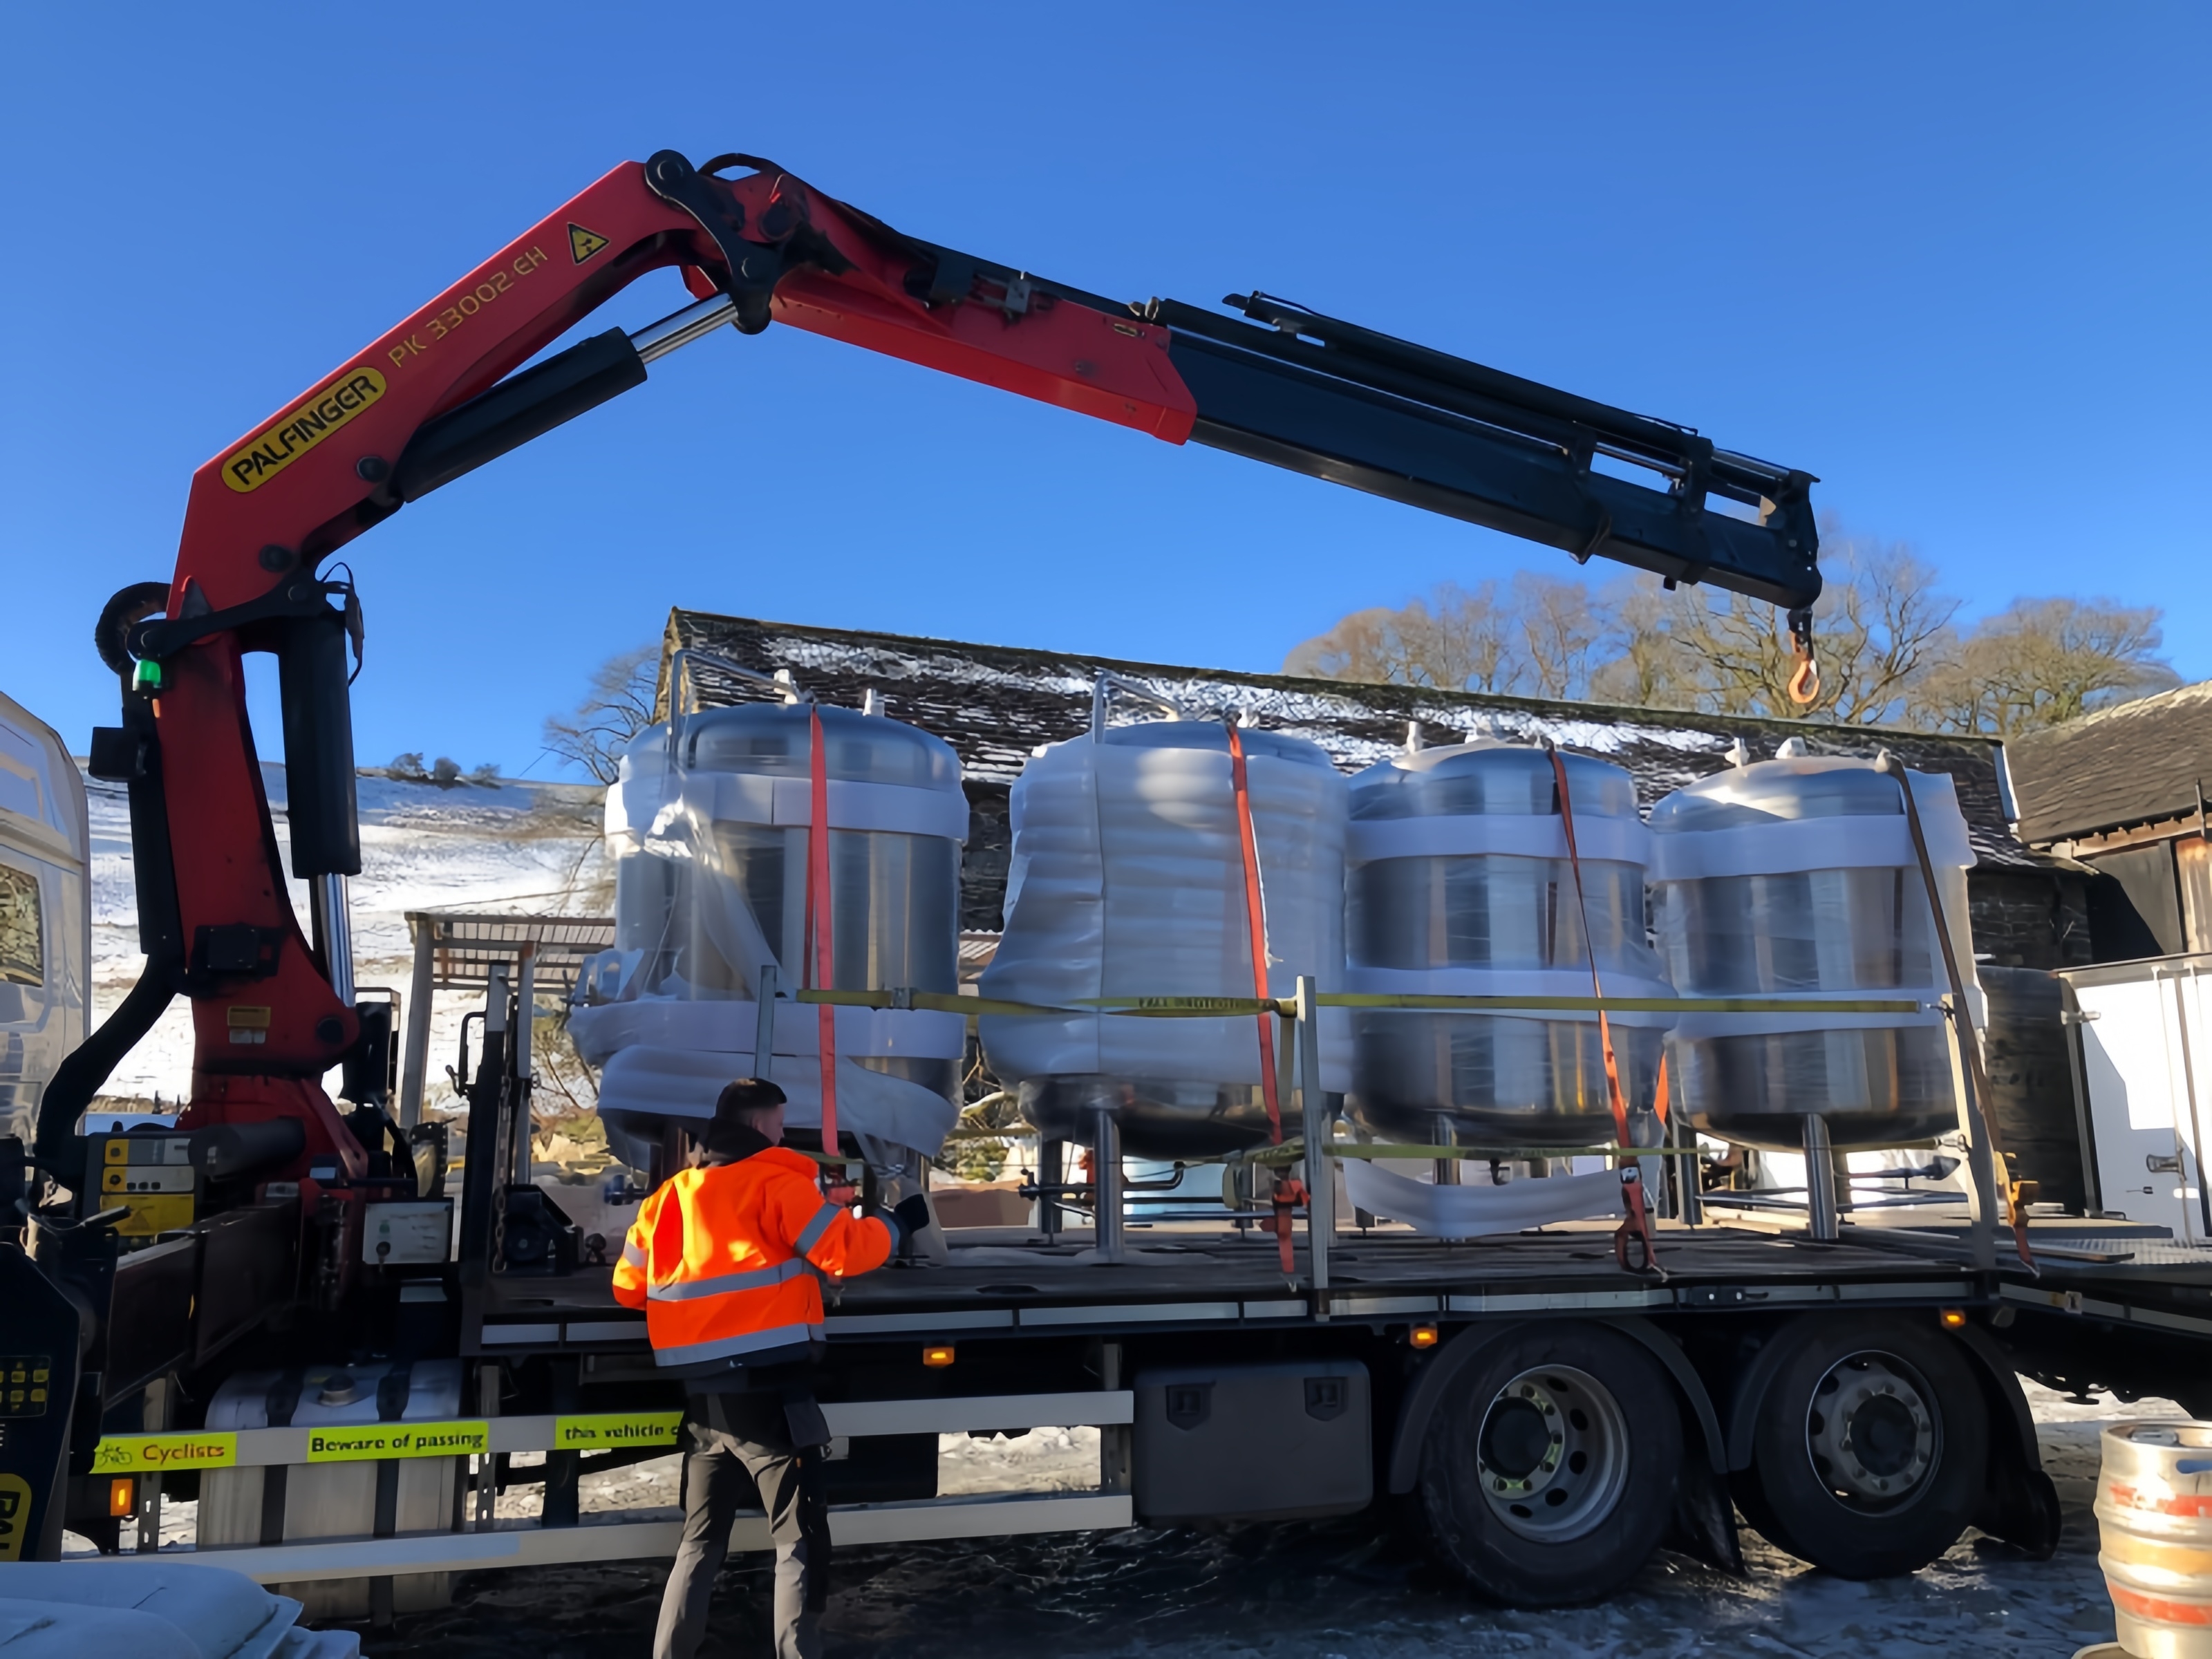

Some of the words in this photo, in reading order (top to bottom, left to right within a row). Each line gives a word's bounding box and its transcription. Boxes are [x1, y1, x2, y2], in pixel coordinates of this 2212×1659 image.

[387, 335, 427, 368] PK
[231, 375, 379, 486] PALFINGER
[143, 1443, 225, 1465] Cyclists
[311, 1436, 385, 1452] Beware
[392, 1433, 411, 1449] of
[416, 1434, 484, 1450] passing
